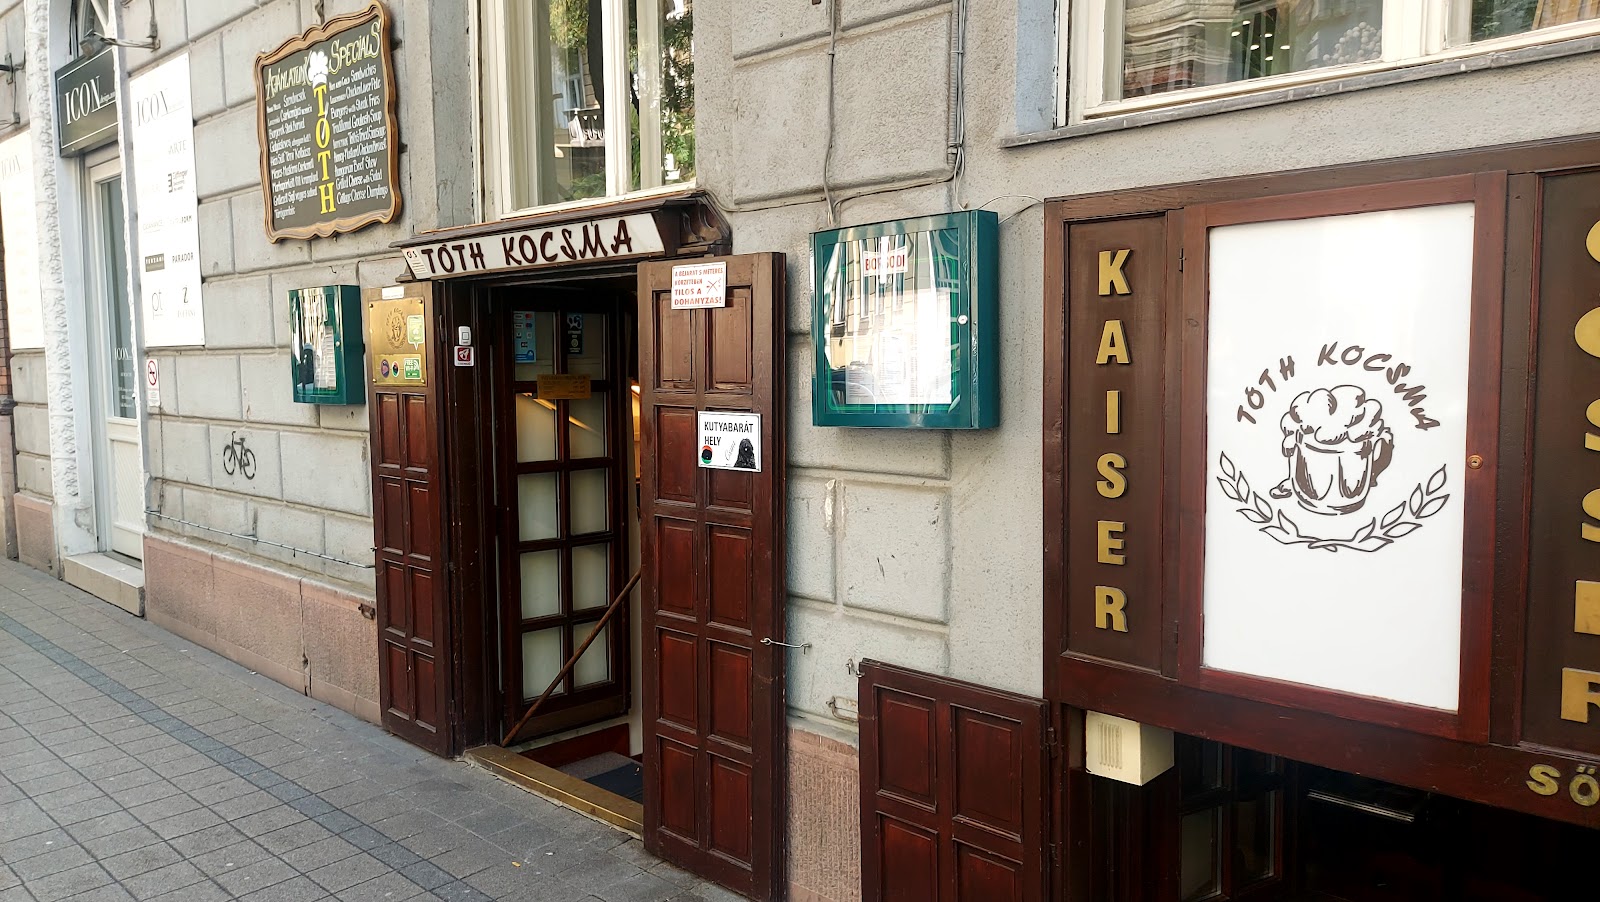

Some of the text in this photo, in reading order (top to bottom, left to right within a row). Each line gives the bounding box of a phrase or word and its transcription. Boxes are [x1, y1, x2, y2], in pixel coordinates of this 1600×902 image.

[65, 75, 100, 125] ICON
[172, 252, 194, 264] PARADOR
[420, 219, 632, 274] TÓTH KOCSMA
[1237, 341, 1441, 430] TÓTH KOCSMA
[704, 420, 754, 433] KUTYABARÁT
[704, 436, 721, 446] HELY
[1095, 249, 1131, 632] KAISER
